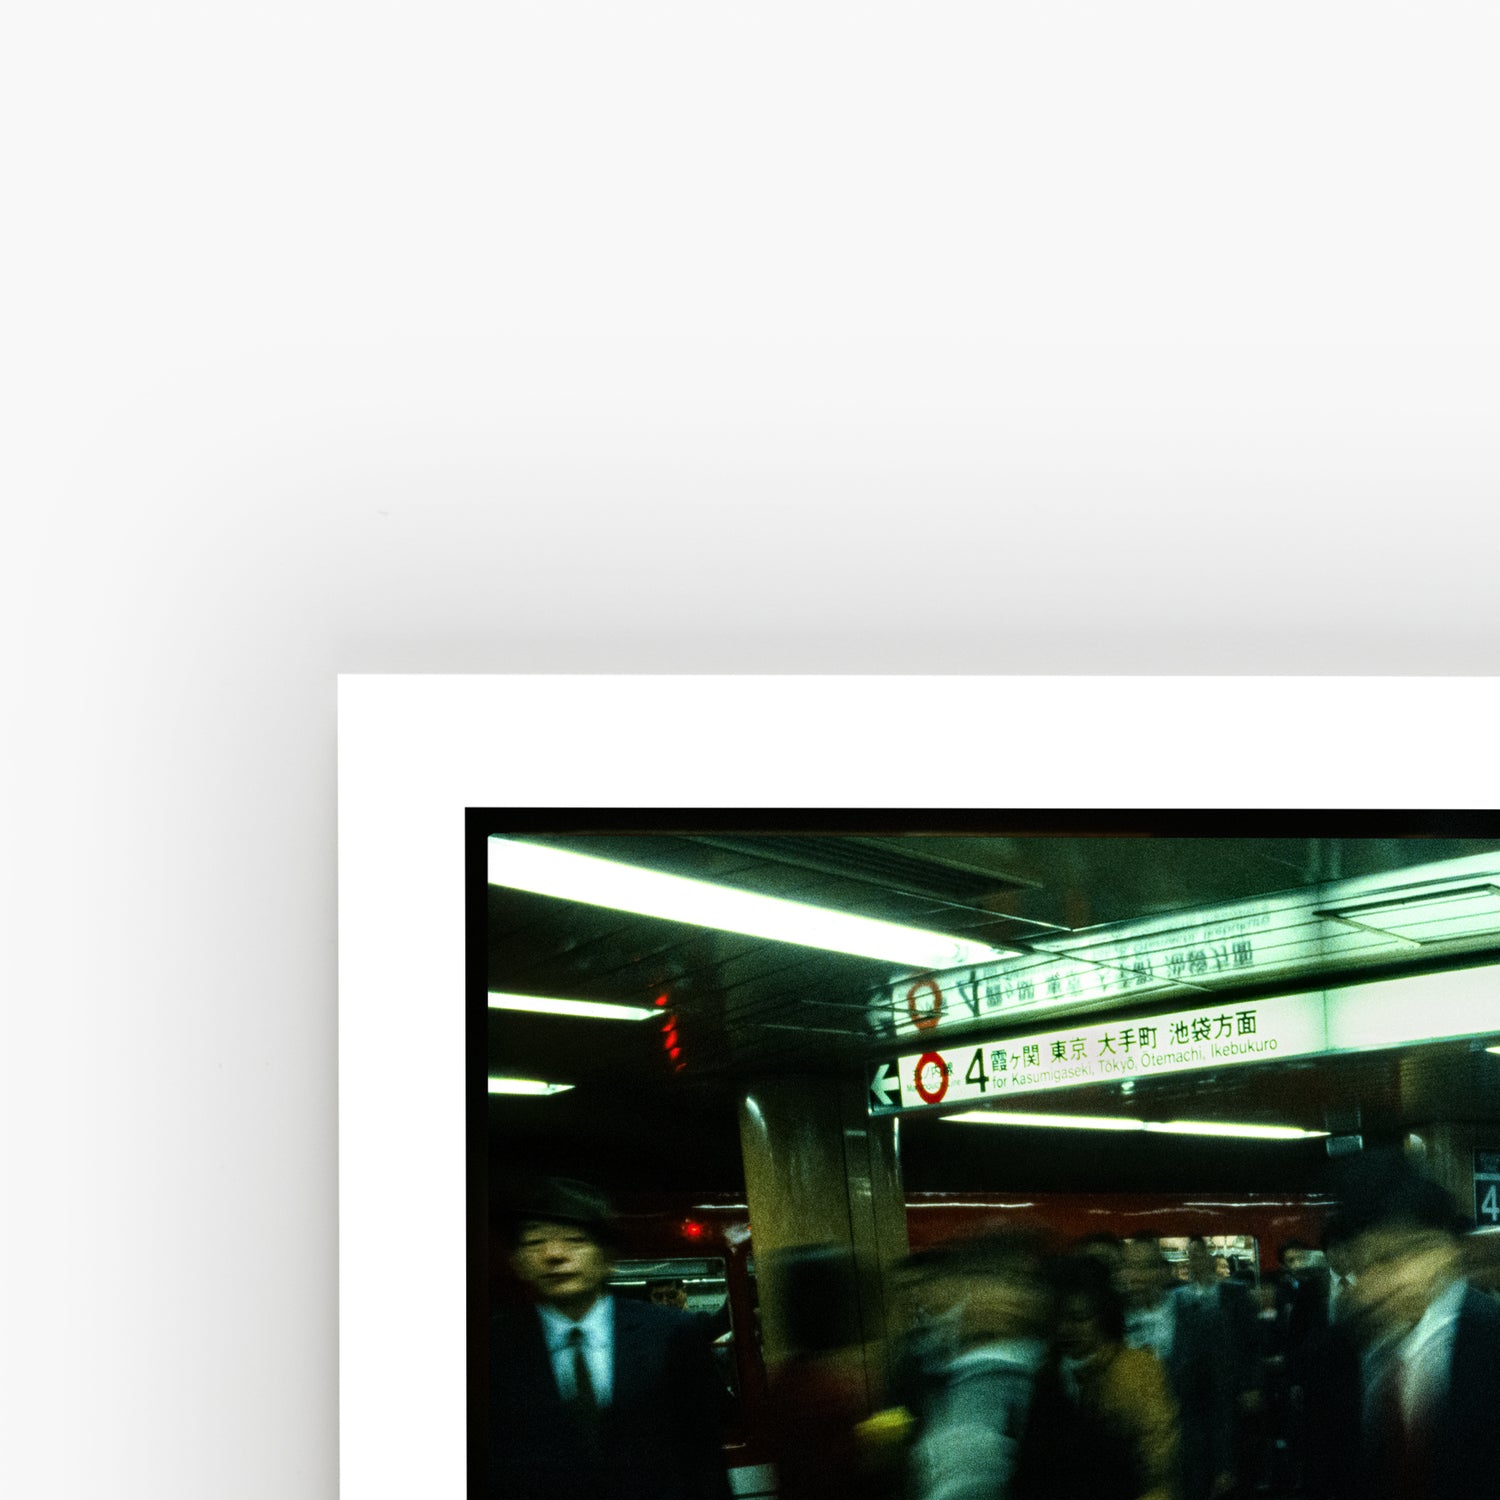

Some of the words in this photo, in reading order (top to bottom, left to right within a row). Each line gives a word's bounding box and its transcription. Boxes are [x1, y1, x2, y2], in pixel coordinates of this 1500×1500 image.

[966, 1048, 989, 1093] 4
[1050, 1037, 1088, 1063] 東京
[1098, 1027, 1157, 1057] 大手町
[1170, 1009, 1257, 1046] 池袋方面
[992, 1075, 1008, 1089] for
[1210, 1037, 1278, 1059] Ikebukuro
[1481, 1184, 1500, 1222] 4
